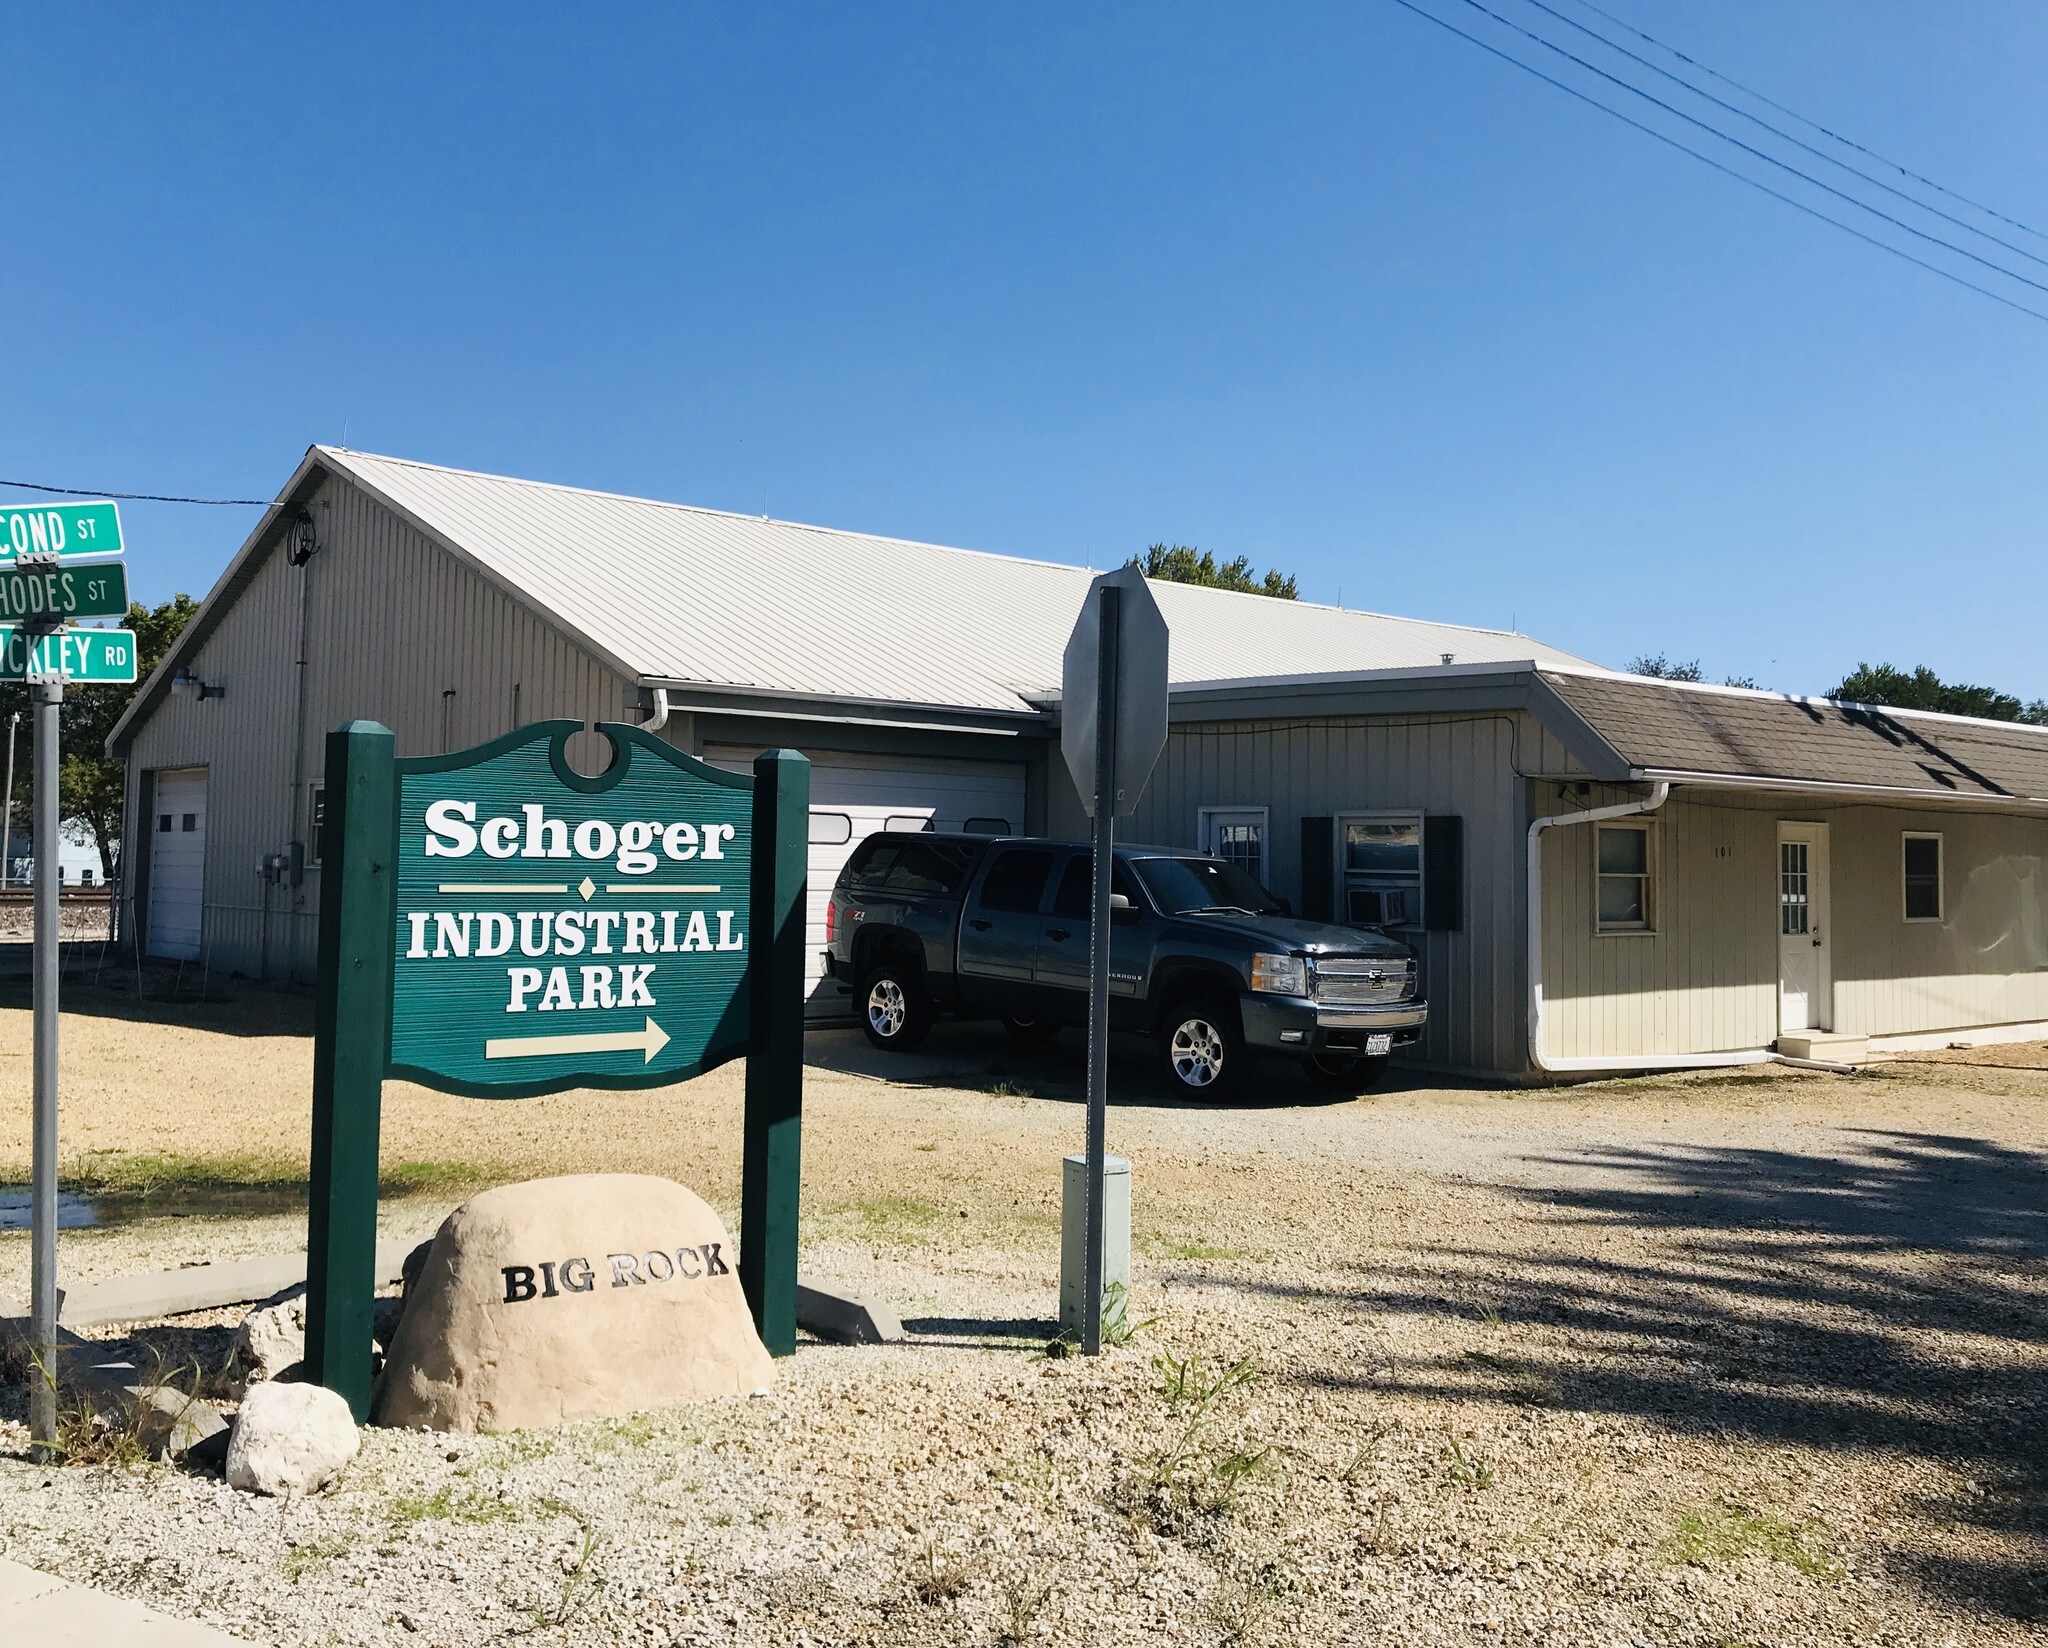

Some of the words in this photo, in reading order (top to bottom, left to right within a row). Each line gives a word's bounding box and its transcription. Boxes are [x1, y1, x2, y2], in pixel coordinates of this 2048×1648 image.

[77, 518, 96, 540] ST
[88, 580, 106, 600] ST
[105, 646, 126, 667] RD
[424, 800, 735, 874] Schoger
[1715, 846, 1732, 858] 101
[405, 910, 743, 959] INDUSTRIAL
[506, 964, 657, 1012] PARK
[501, 1257, 595, 1304] BIG
[607, 1242, 730, 1288] ROCK
